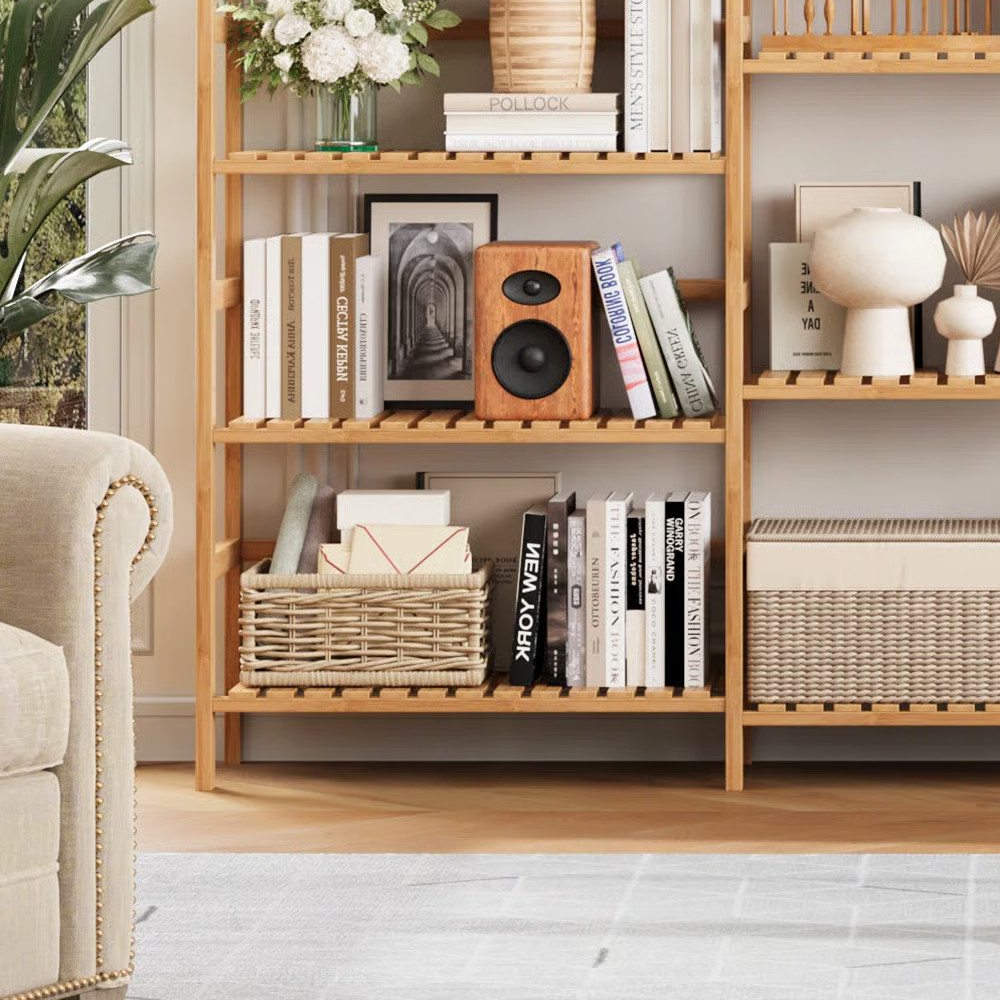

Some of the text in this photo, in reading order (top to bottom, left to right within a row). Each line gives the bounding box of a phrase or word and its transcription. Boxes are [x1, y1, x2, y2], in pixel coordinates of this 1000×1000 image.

[629, 27, 643, 80] STYLE
[489, 96, 570, 111] POLLOCK
[666, 517, 675, 582] WINOGRAND
[675, 517, 683, 553] GARRY
[688, 524, 700, 561] BOOK
[610, 504, 619, 683] THE FASHION BOOK
[688, 566, 700, 595] THE
[688, 598, 700, 655] FASHION
